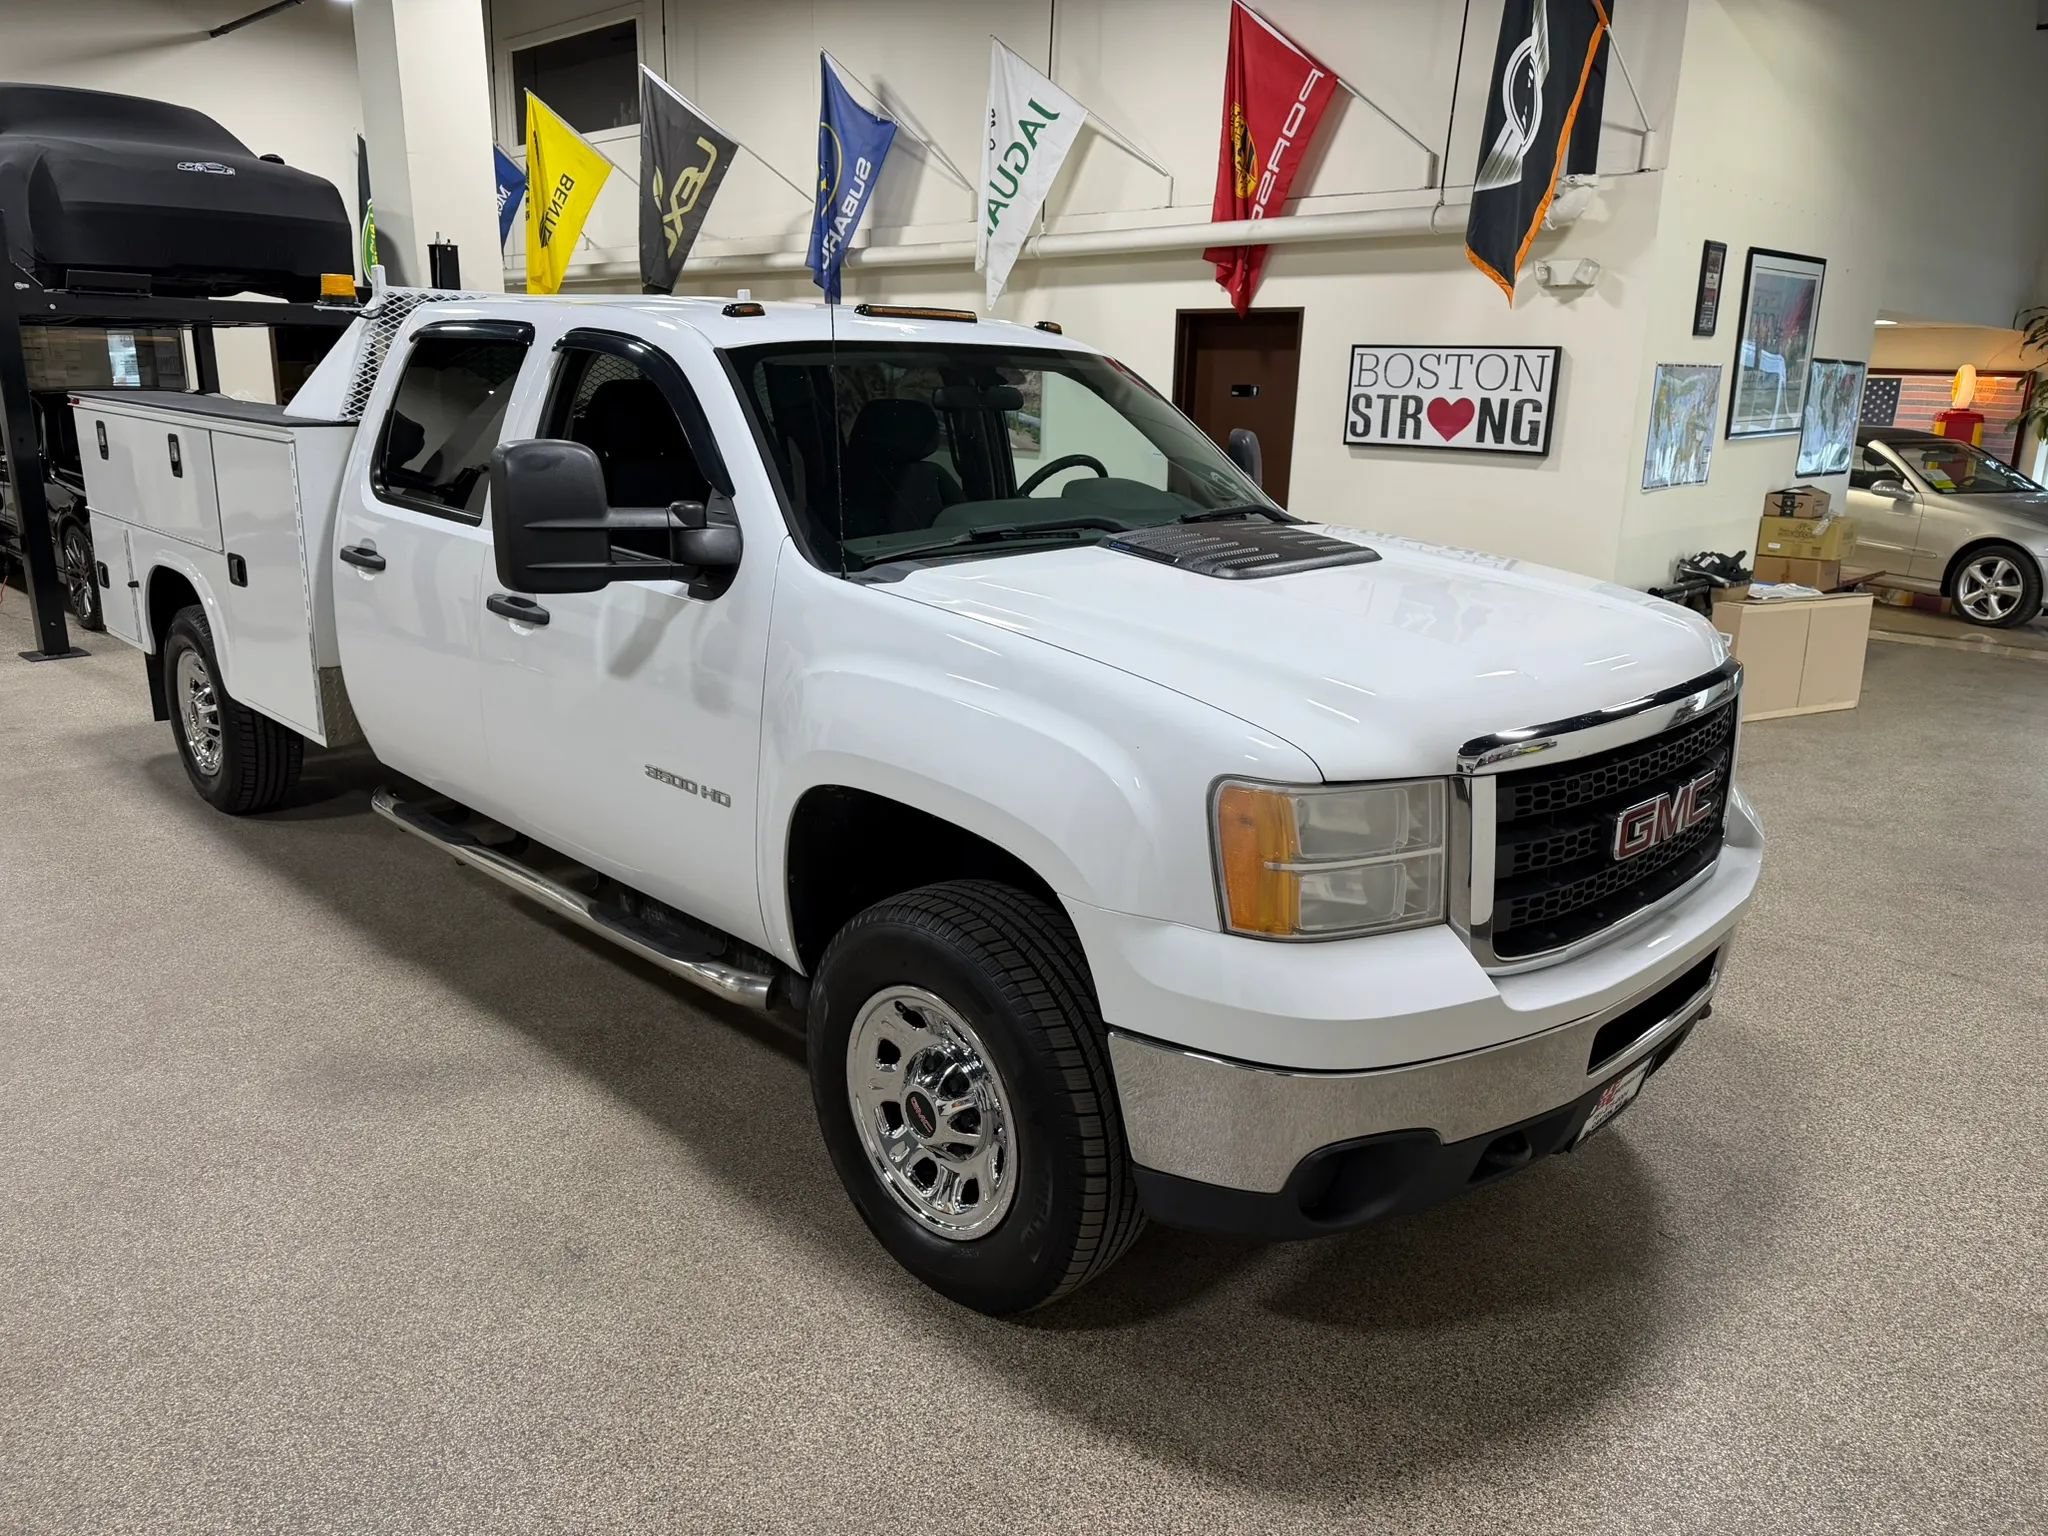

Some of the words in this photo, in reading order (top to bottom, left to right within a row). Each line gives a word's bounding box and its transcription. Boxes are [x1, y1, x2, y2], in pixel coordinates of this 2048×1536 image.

[1353, 353, 1550, 392] BOSTON
[1350, 393, 1543, 447] STRNG
[701, 785, 731, 808] HD
[1614, 769, 1716, 860] GMC
